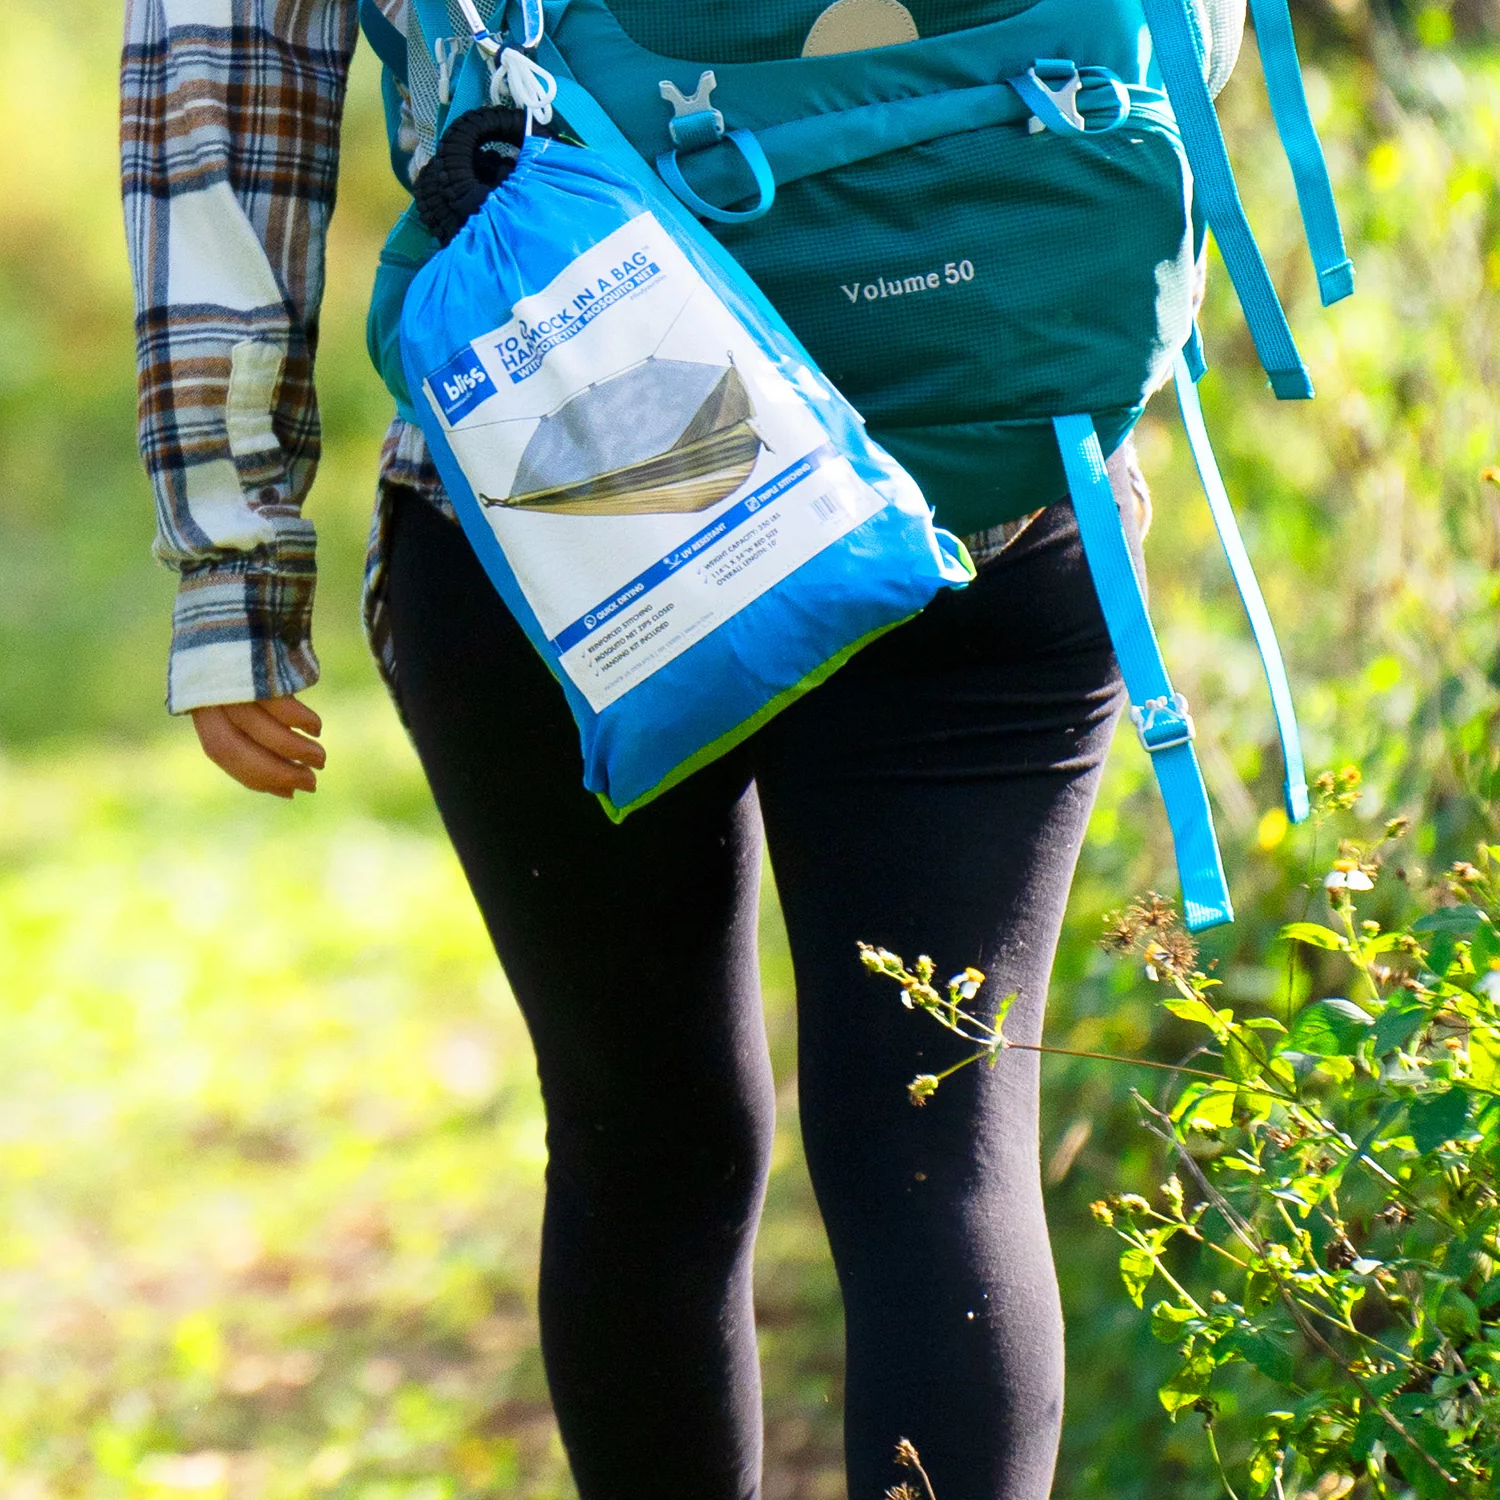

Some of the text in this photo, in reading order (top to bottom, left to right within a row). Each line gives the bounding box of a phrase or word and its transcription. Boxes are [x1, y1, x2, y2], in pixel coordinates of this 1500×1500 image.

[572, 288, 596, 311] IN
[596, 277, 612, 292] A
[610, 251, 648, 282] BAG
[584, 282, 635, 322] MOSQUITO
[634, 268, 655, 287] NET
[840, 259, 975, 304] Volume 50
[494, 336, 519, 357] TO
[443, 367, 486, 401] bliss
[757, 484, 780, 503] TRIPLE
[680, 521, 727, 560] UV RESISTANT
[703, 549, 730, 570] WEIGHT
[716, 565, 744, 586] OVERALL
[595, 582, 646, 620] QUICK DRYING
[587, 604, 653, 654] REINFORCED STITCHING
[594, 602, 676, 663] MOSQUITO NET ZIPS CLOSED
[600, 620, 670, 672] HANGING KIT INCLUDED
